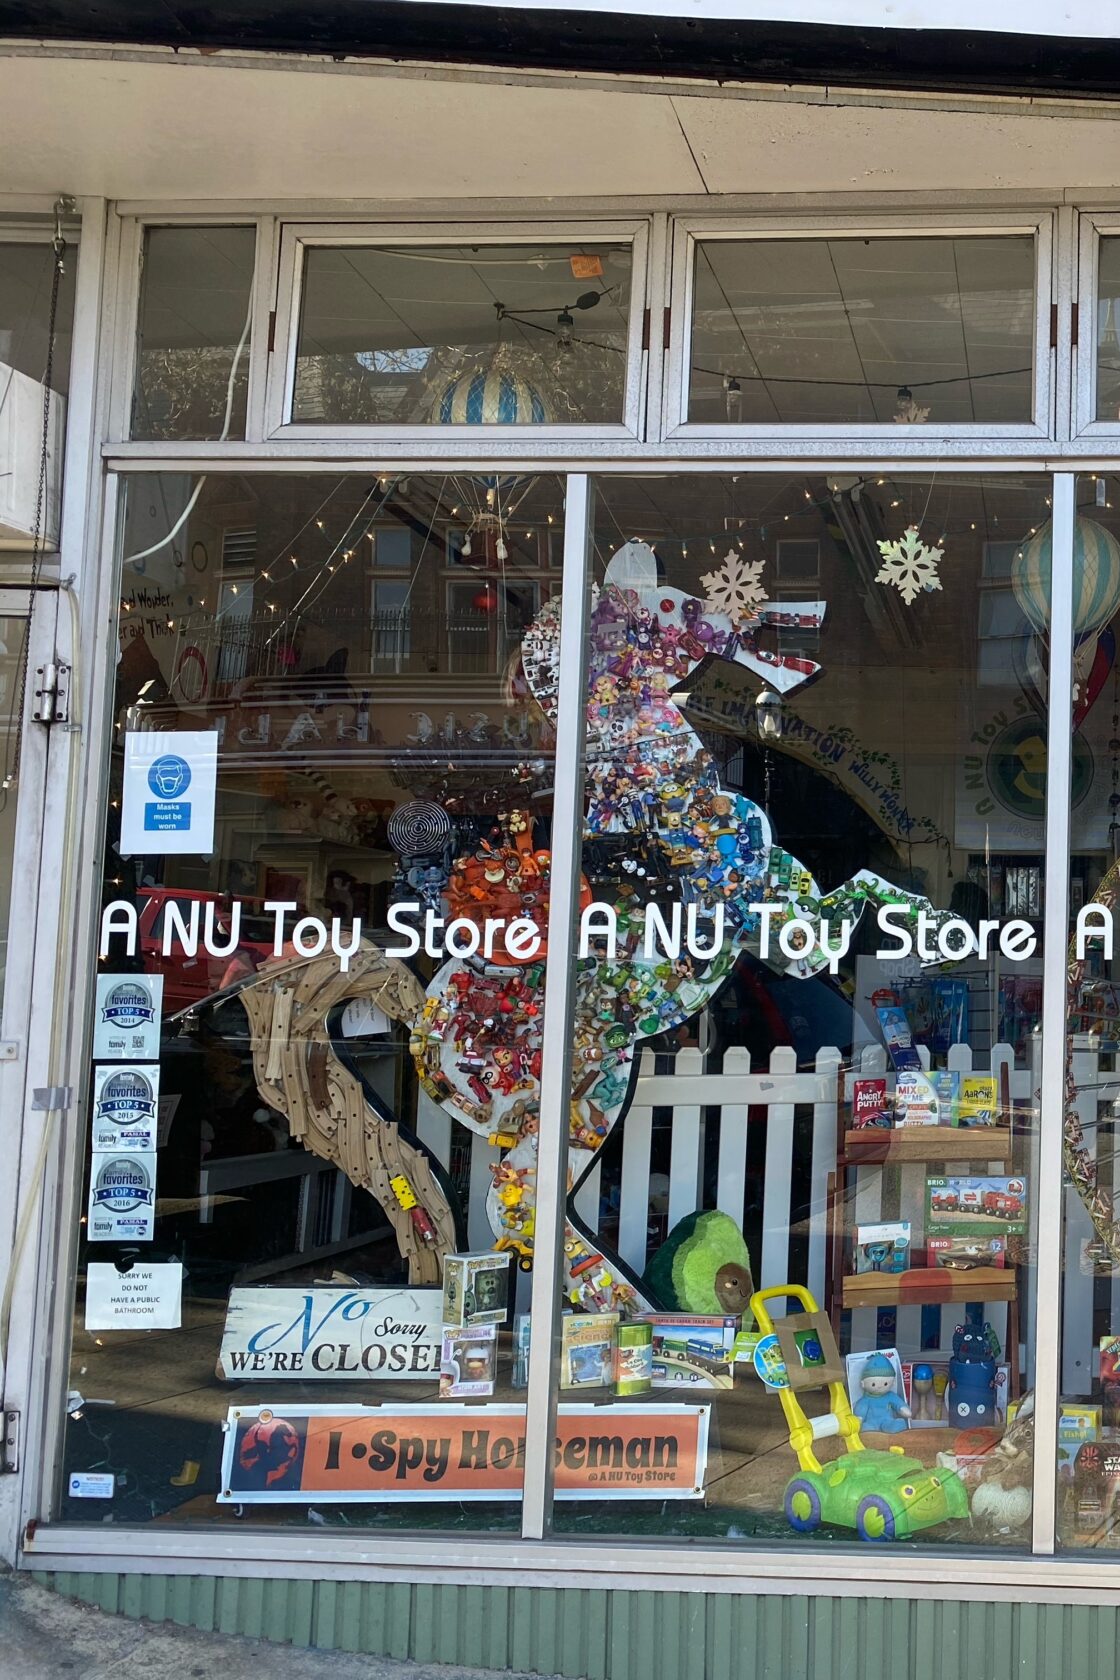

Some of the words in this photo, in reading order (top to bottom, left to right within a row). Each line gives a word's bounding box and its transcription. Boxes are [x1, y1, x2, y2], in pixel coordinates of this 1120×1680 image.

[172, 812, 182, 820] be
[100, 901, 137, 957] A
[162, 901, 240, 958] NU
[264, 902, 362, 972] Toy
[385, 903, 541, 960] Store
[1076, 903, 1113, 960] A
[579, 903, 616, 959] A
[644, 903, 724, 960] NU
[748, 904, 850, 974] Toy
[876, 904, 1037, 961] Store
[111, 994, 147, 1005] favorites
[115, 1007, 132, 1015] TOP
[107, 1086, 147, 1098] favorites
[857, 1090, 882, 1102] ANGRY
[112, 1100, 132, 1109] TOP
[134, 1101, 139, 1109] 5
[857, 1100, 882, 1112] PUTTY
[103, 1173, 143, 1185] favorites
[108, 1188, 129, 1197] TOP
[130, 1189, 136, 1197] 5
[113, 1199, 131, 1207] 2016
[374, 1316, 427, 1343] Sorry
[229, 1351, 304, 1371] WE'RE
[311, 1343, 441, 1372] CLOSE
[324, 1430, 342, 1470] I
[368, 1430, 451, 1482] Spy
[599, 1472, 607, 1481] A
[624, 1471, 643, 1483] Toy
[645, 1470, 676, 1482] Store
